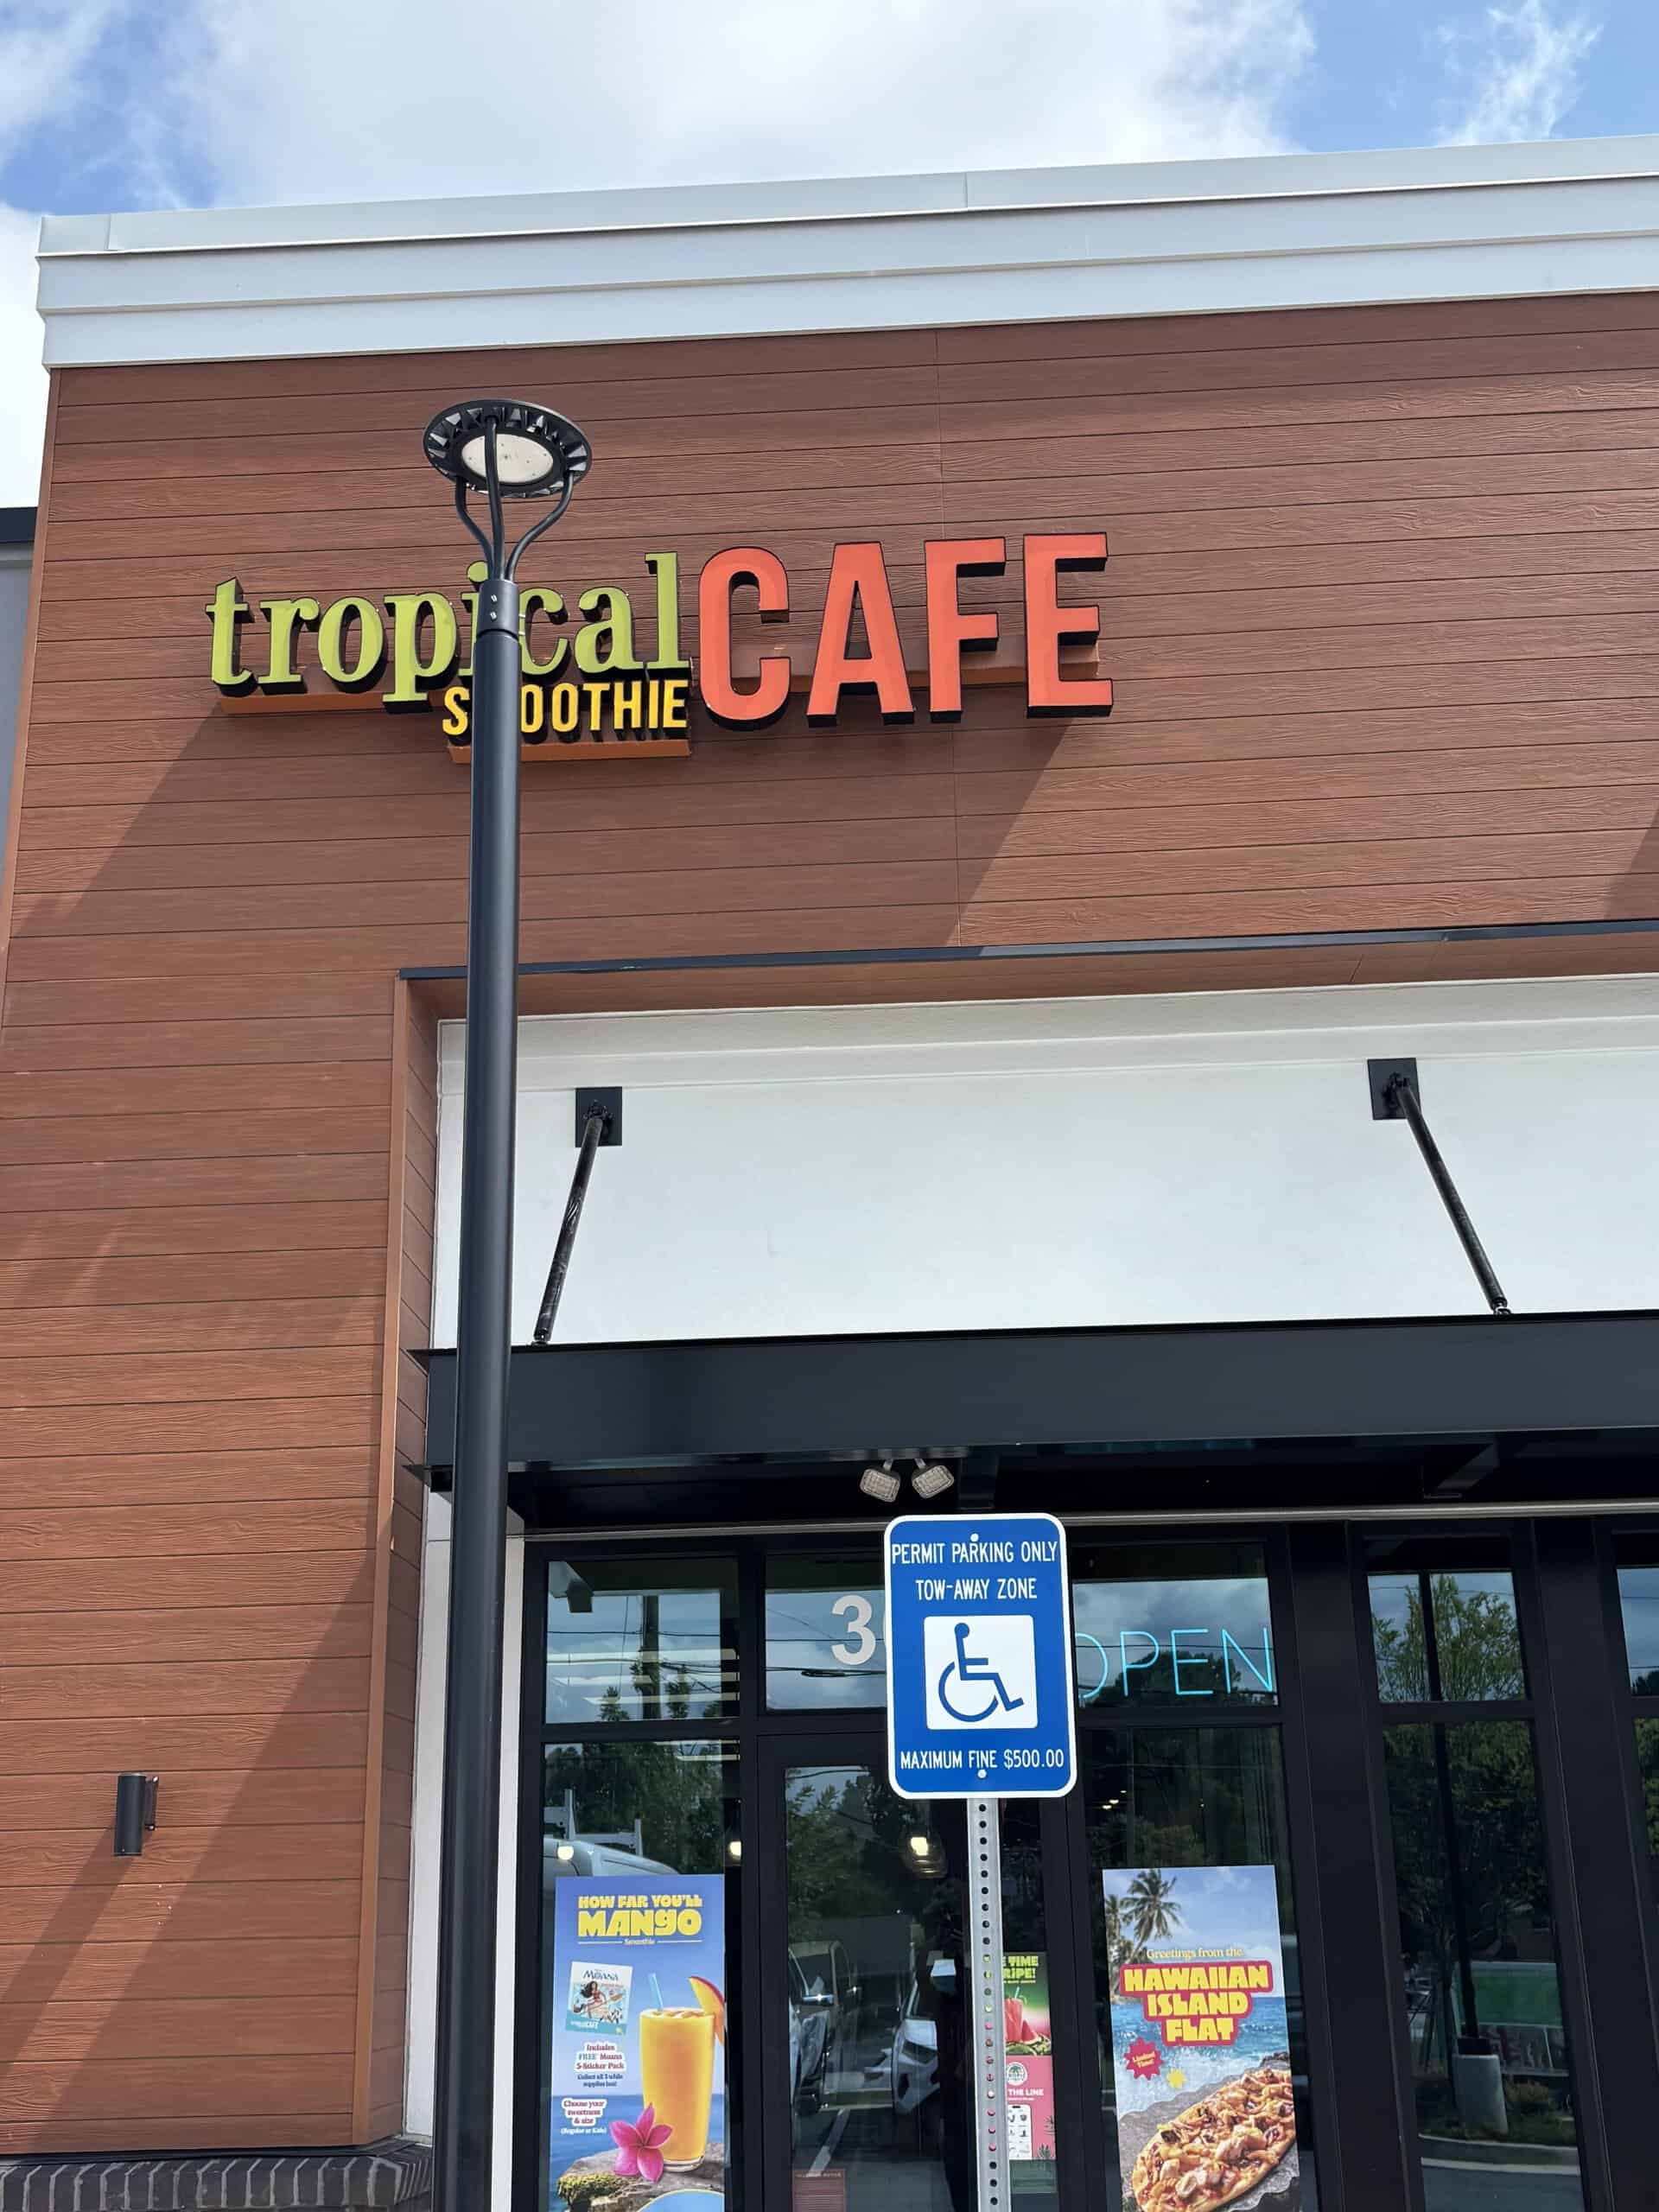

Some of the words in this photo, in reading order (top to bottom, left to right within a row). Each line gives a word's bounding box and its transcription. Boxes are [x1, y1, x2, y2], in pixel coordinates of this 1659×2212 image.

[698, 531, 1114, 721] CAFE
[442, 679, 689, 735] SOOTHIE
[892, 1542, 945, 1565] PERMIT
[952, 1541, 1014, 1563] PARKING
[1020, 1541, 1058, 1562] ONLY
[915, 1579, 989, 1601] TOW-AWAY
[997, 1578, 1037, 1599] ZONE
[831, 1594, 886, 1666] 3
[900, 1751, 963, 1770] MAXIMUM
[969, 1750, 997, 1769] FINE
[1003, 1749, 1065, 1770] $500.00
[578, 1895, 615, 1909] HOW
[618, 1895, 648, 1908] FAR
[1007, 1955, 1039, 1967] TIME
[1147, 1948, 1196, 1961] Greetings
[1198, 1948, 1224, 1958] from
[1124, 1965, 1269, 1992] HAWAIIAN
[1147, 1992, 1249, 2017] ISLAND
[1166, 2018, 1234, 2042] FLAT
